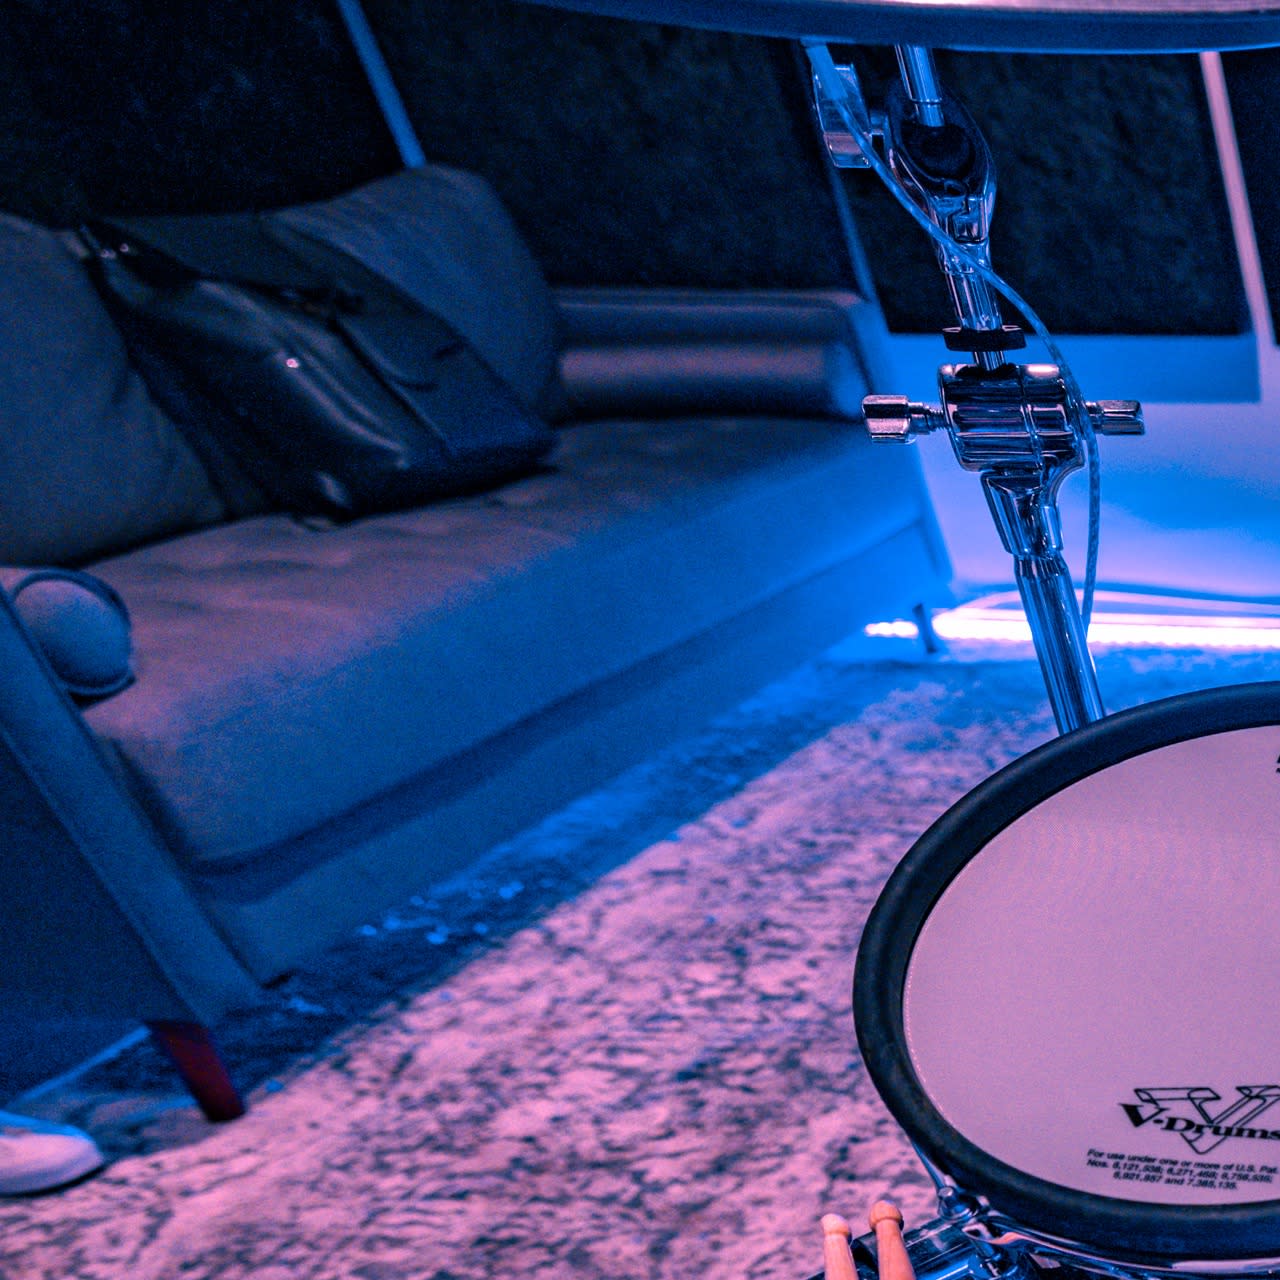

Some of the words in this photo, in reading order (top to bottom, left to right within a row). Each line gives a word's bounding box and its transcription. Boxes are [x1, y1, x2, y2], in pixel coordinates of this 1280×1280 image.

[1087, 1148, 1104, 1158] For
[1106, 1152, 1126, 1160] use
[1127, 1154, 1157, 1163] under
[1164, 1177, 1184, 1186] and
